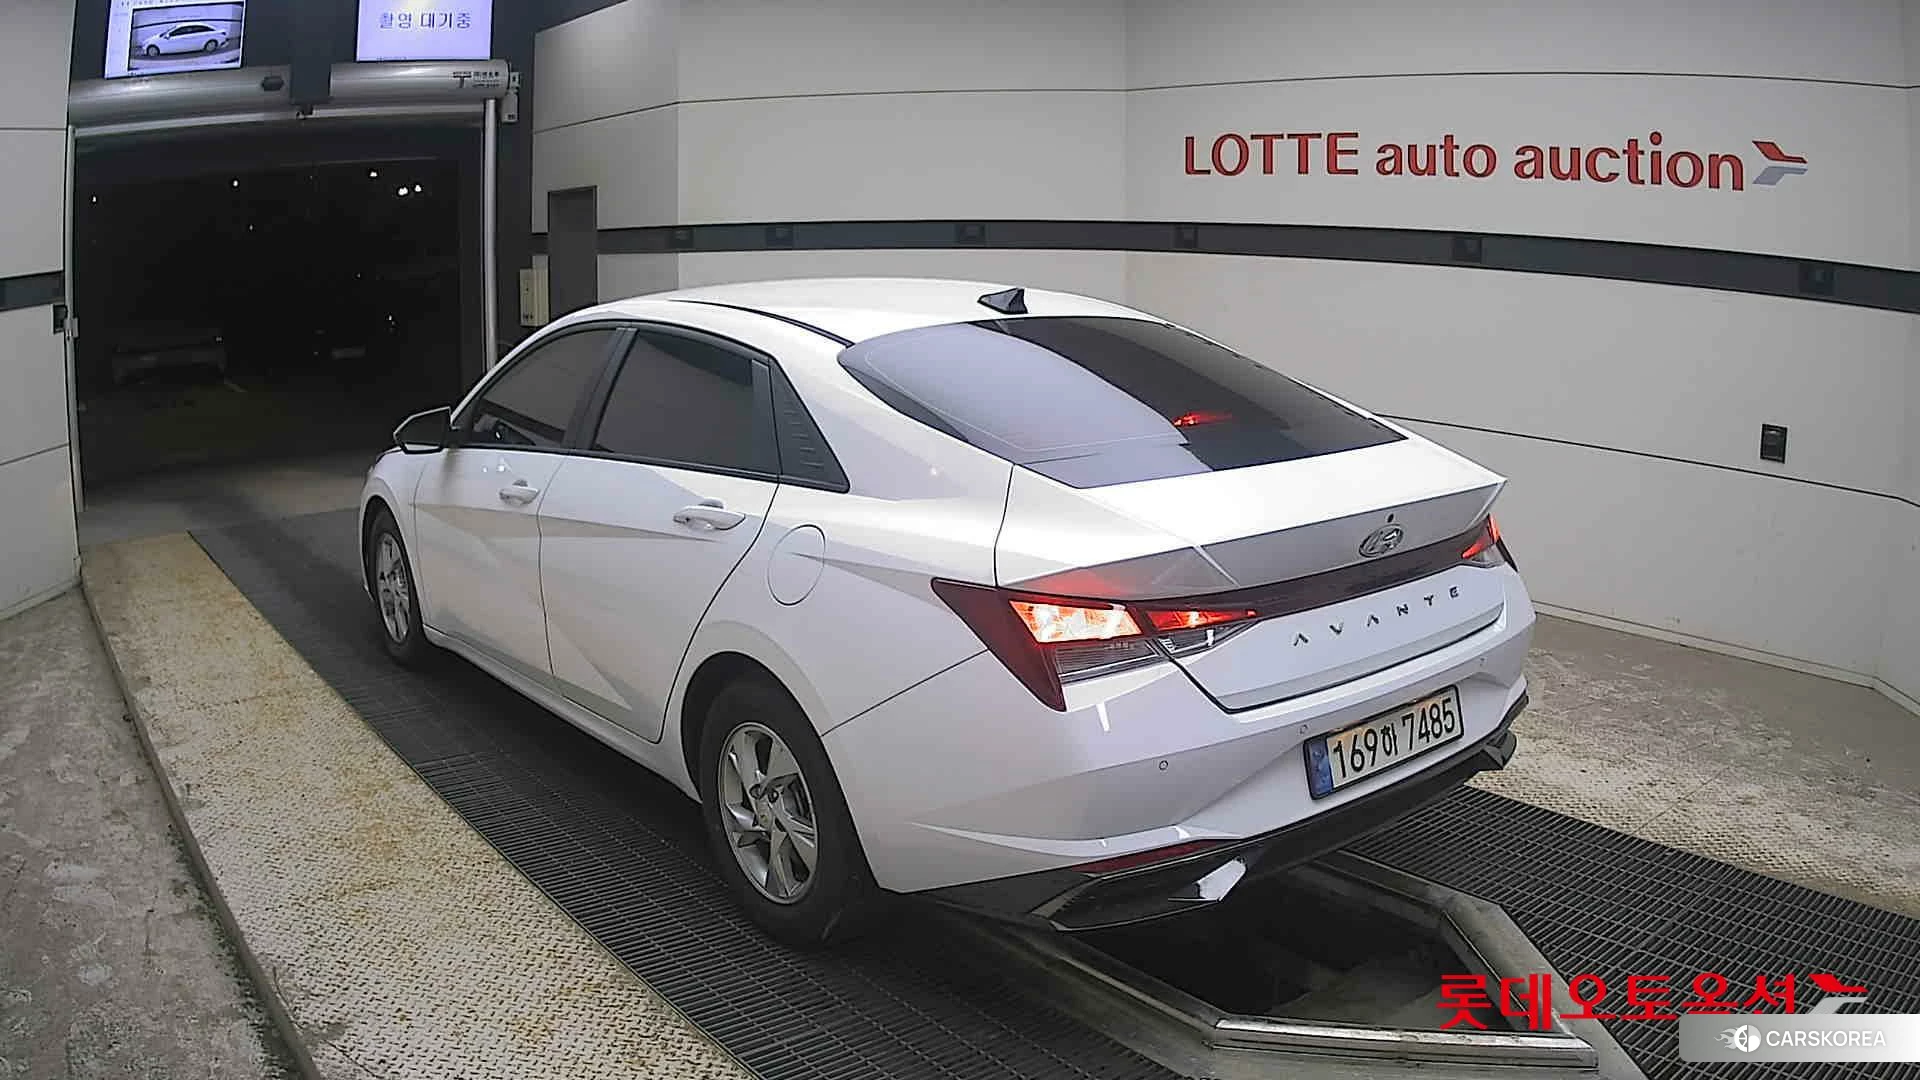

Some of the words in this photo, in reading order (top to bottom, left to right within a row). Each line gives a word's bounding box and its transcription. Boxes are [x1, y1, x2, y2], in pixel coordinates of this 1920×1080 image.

[420, 11, 472, 29] 대기중
[1184, 132, 1359, 176] LOTTE
[1376, 134, 1498, 178] auto
[1513, 131, 1745, 192] auction
[1293, 586, 1460, 647] AVANTE
[1333, 722, 1399, 779] 169하
[1401, 697, 1456, 751] 7485
